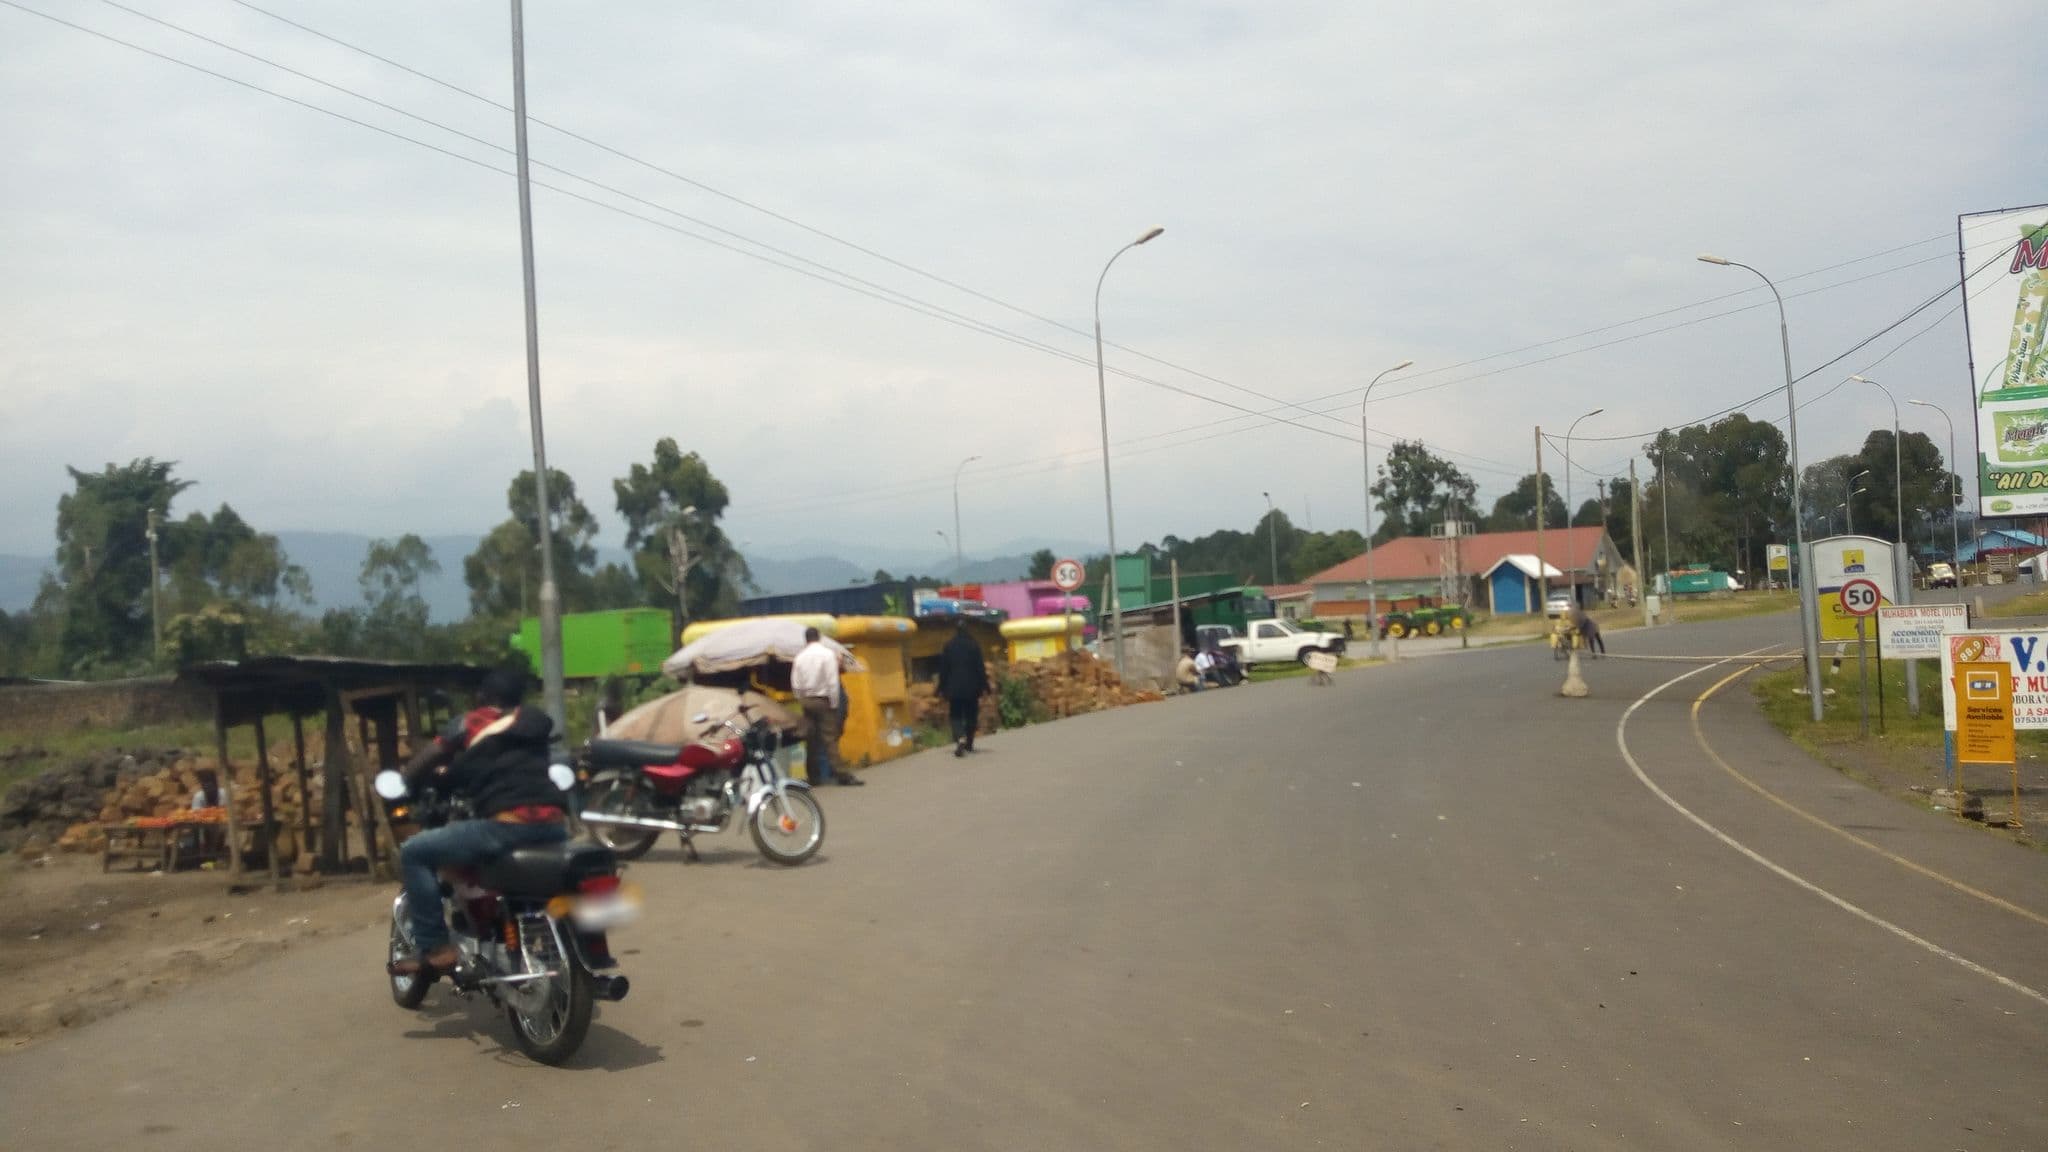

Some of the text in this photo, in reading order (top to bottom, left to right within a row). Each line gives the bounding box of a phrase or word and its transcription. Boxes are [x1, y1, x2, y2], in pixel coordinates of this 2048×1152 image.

[1060, 568, 1077, 581] 50
[1848, 589, 1875, 606] 50
[1960, 640, 1981, 661] 88.9
[1967, 706, 2003, 714] Services
[1966, 713, 2004, 721] Available
